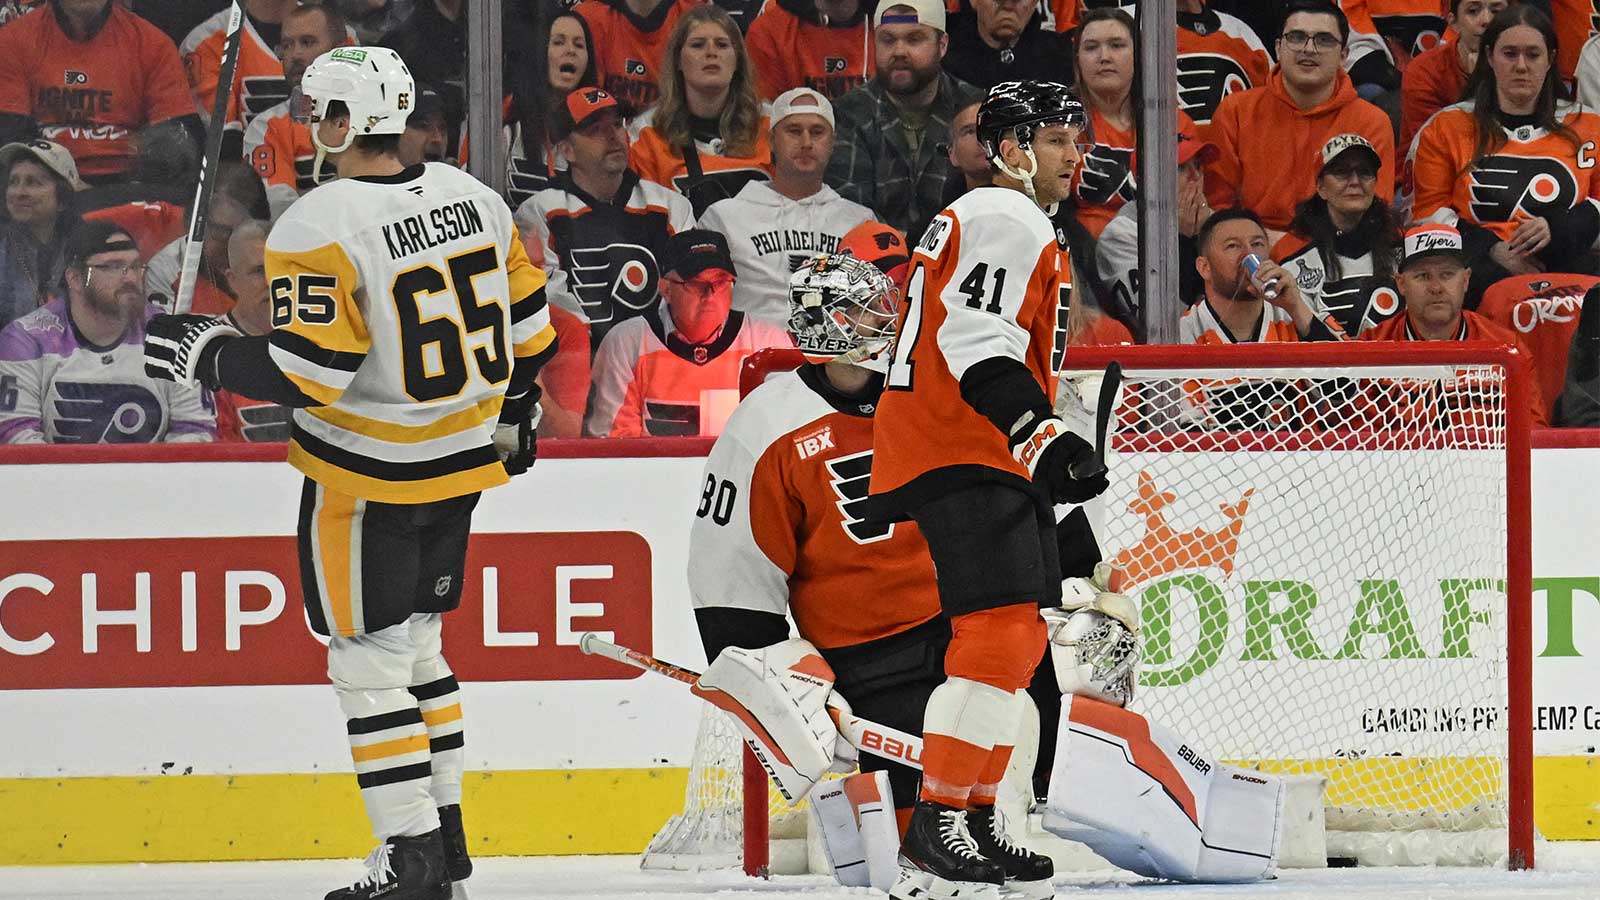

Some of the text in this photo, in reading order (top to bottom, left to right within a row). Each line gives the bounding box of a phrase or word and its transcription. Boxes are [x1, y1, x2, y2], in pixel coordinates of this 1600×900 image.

[398, 93, 409, 110] 65
[1577, 141, 1596, 169] C
[382, 200, 484, 260] KARLSSON
[1415, 233, 1456, 251] Flyers
[270, 274, 338, 328] 65
[959, 262, 1008, 315] 41
[389, 242, 512, 403] 65
[799, 336, 858, 350] FLYERS
[795, 431, 835, 460] IBX
[0, 565, 615, 656] CHIPLE
[1362, 707, 1467, 733] GAMBING
[1232, 773, 1268, 785] SHADOW
